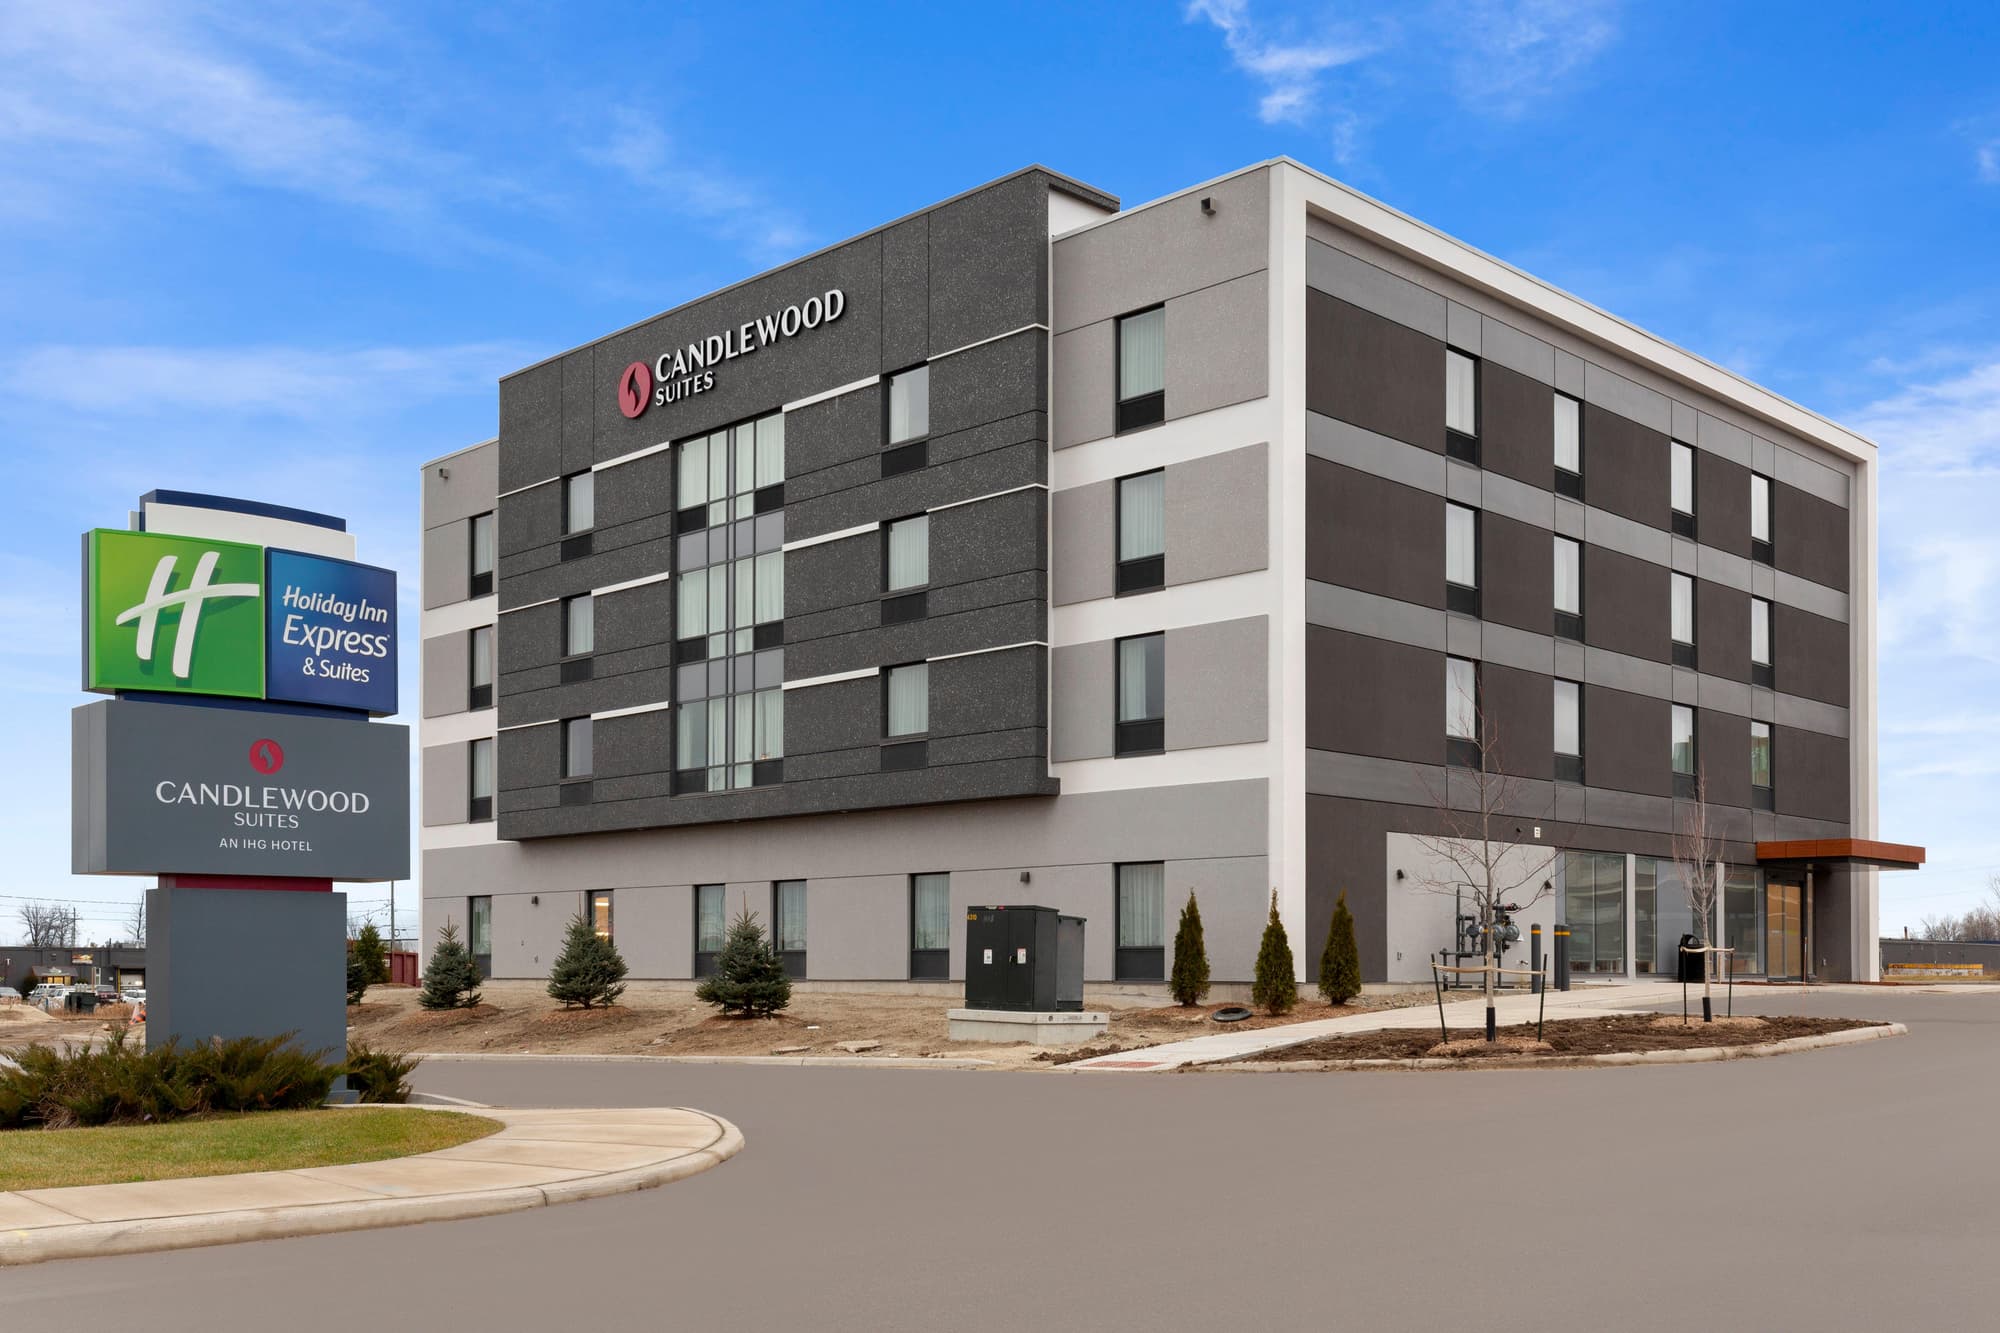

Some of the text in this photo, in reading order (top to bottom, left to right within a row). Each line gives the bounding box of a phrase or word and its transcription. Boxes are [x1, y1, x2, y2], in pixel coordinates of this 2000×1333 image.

[655, 289, 844, 383] CANDLEWOOD
[655, 370, 713, 406] SUITES
[115, 551, 260, 678] H
[282, 585, 388, 623] Holiday Inn
[283, 614, 388, 657] Express
[302, 657, 370, 683] & Suites
[155, 780, 370, 814] CANDLEWOOD
[234, 812, 299, 829] SUITES
[219, 838, 313, 852] AN IHG HOTEL
